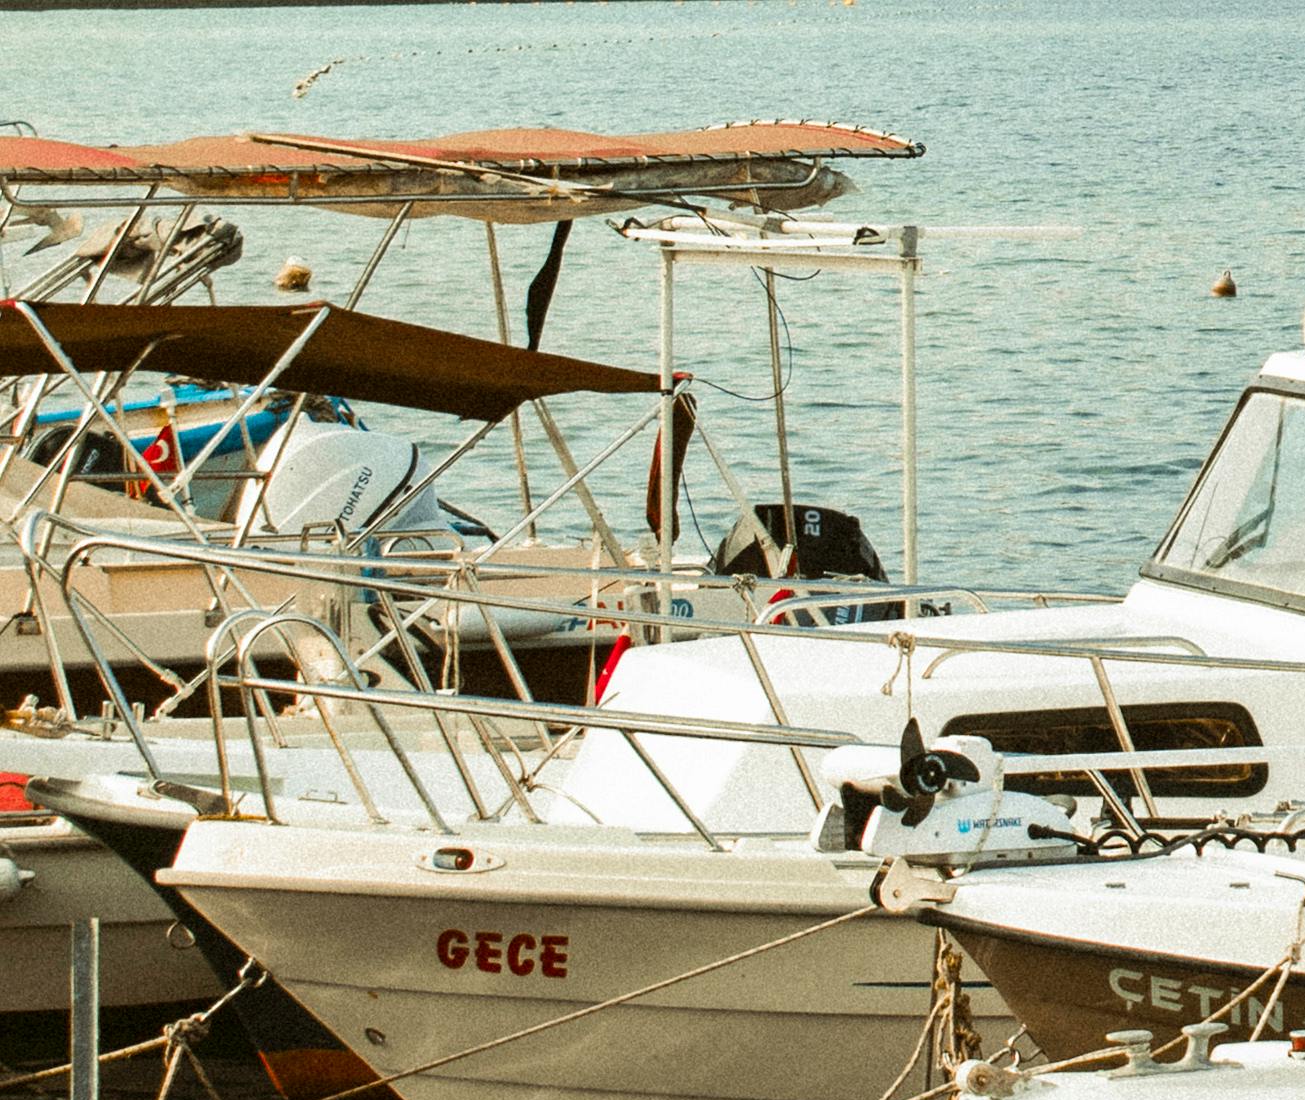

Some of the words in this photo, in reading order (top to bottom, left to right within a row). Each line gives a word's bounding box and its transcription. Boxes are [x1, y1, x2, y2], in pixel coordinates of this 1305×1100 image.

[339, 466, 373, 521] TOHATSU
[804, 510, 820, 537] 20
[973, 816, 1021, 829] WATSNAKE
[436, 928, 569, 979] GECE
